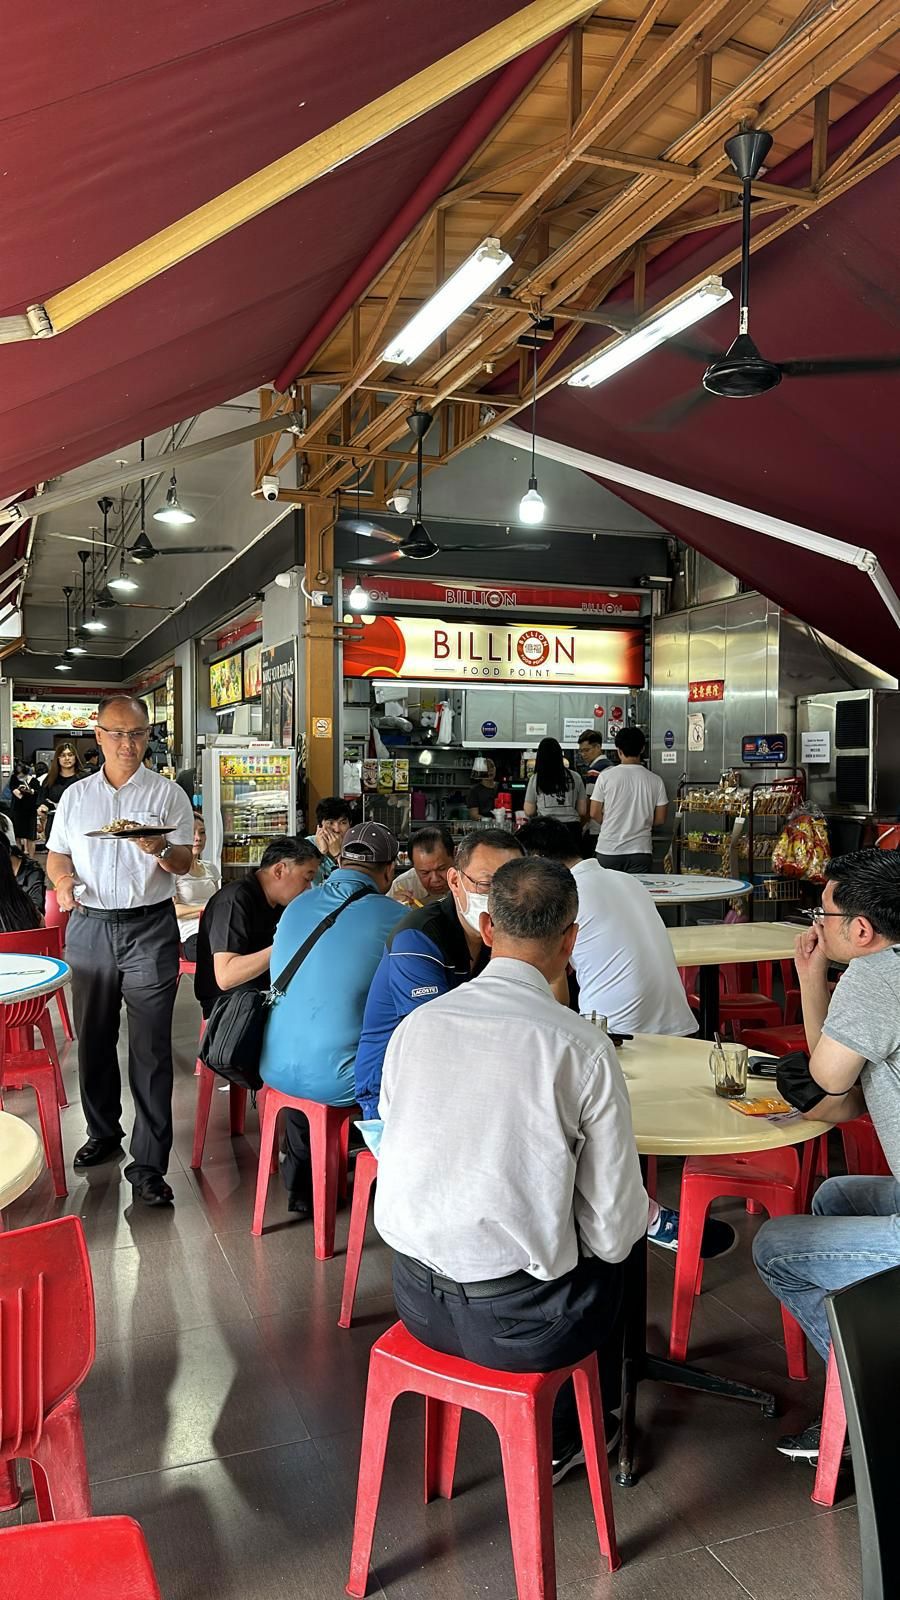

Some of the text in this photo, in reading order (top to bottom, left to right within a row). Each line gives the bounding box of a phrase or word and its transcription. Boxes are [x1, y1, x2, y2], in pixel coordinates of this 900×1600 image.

[445, 590, 517, 608] BILLION
[581, 602, 623, 614] BILLION
[434, 630, 575, 667] BILLION
[463, 667, 550, 677] FOOD POINT
